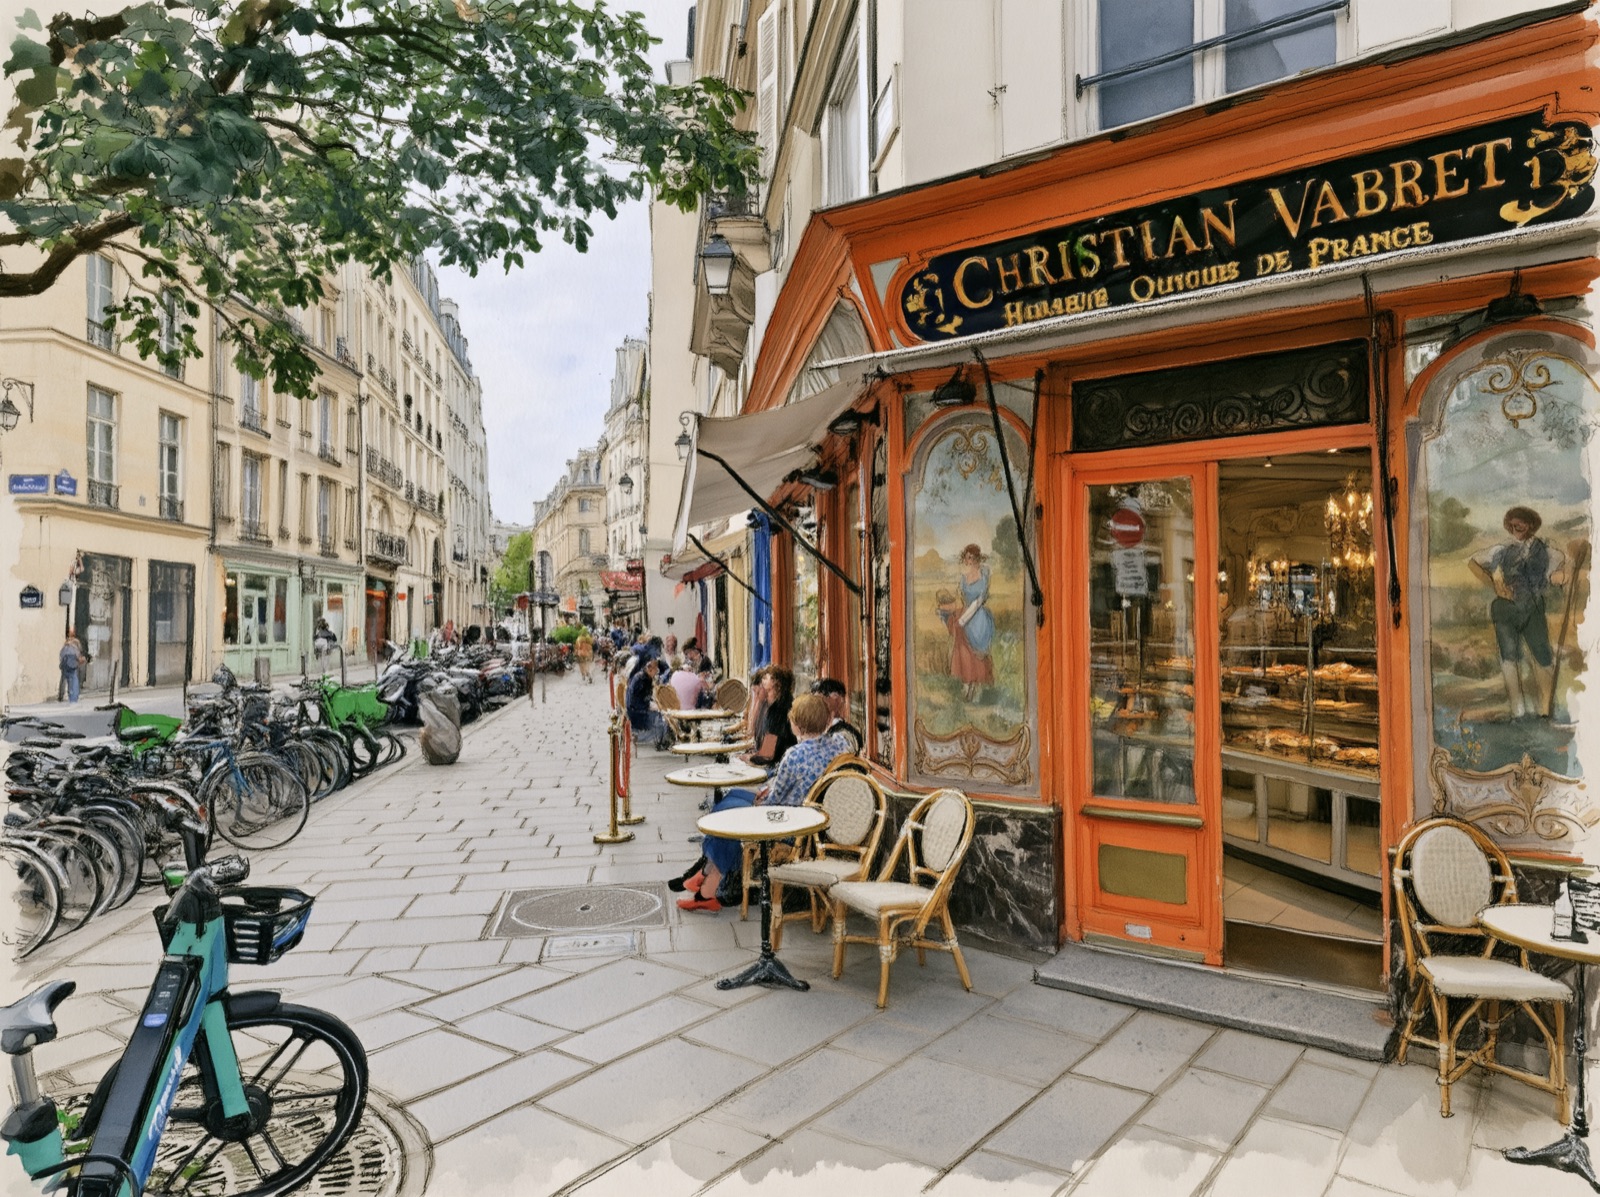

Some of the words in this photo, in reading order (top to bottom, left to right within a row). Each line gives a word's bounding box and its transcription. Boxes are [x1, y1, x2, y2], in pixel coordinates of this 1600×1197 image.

[953, 199, 1238, 309] CHRISTIAN
[1268, 137, 1512, 239] VABRET
[1256, 249, 1293, 276] DE
